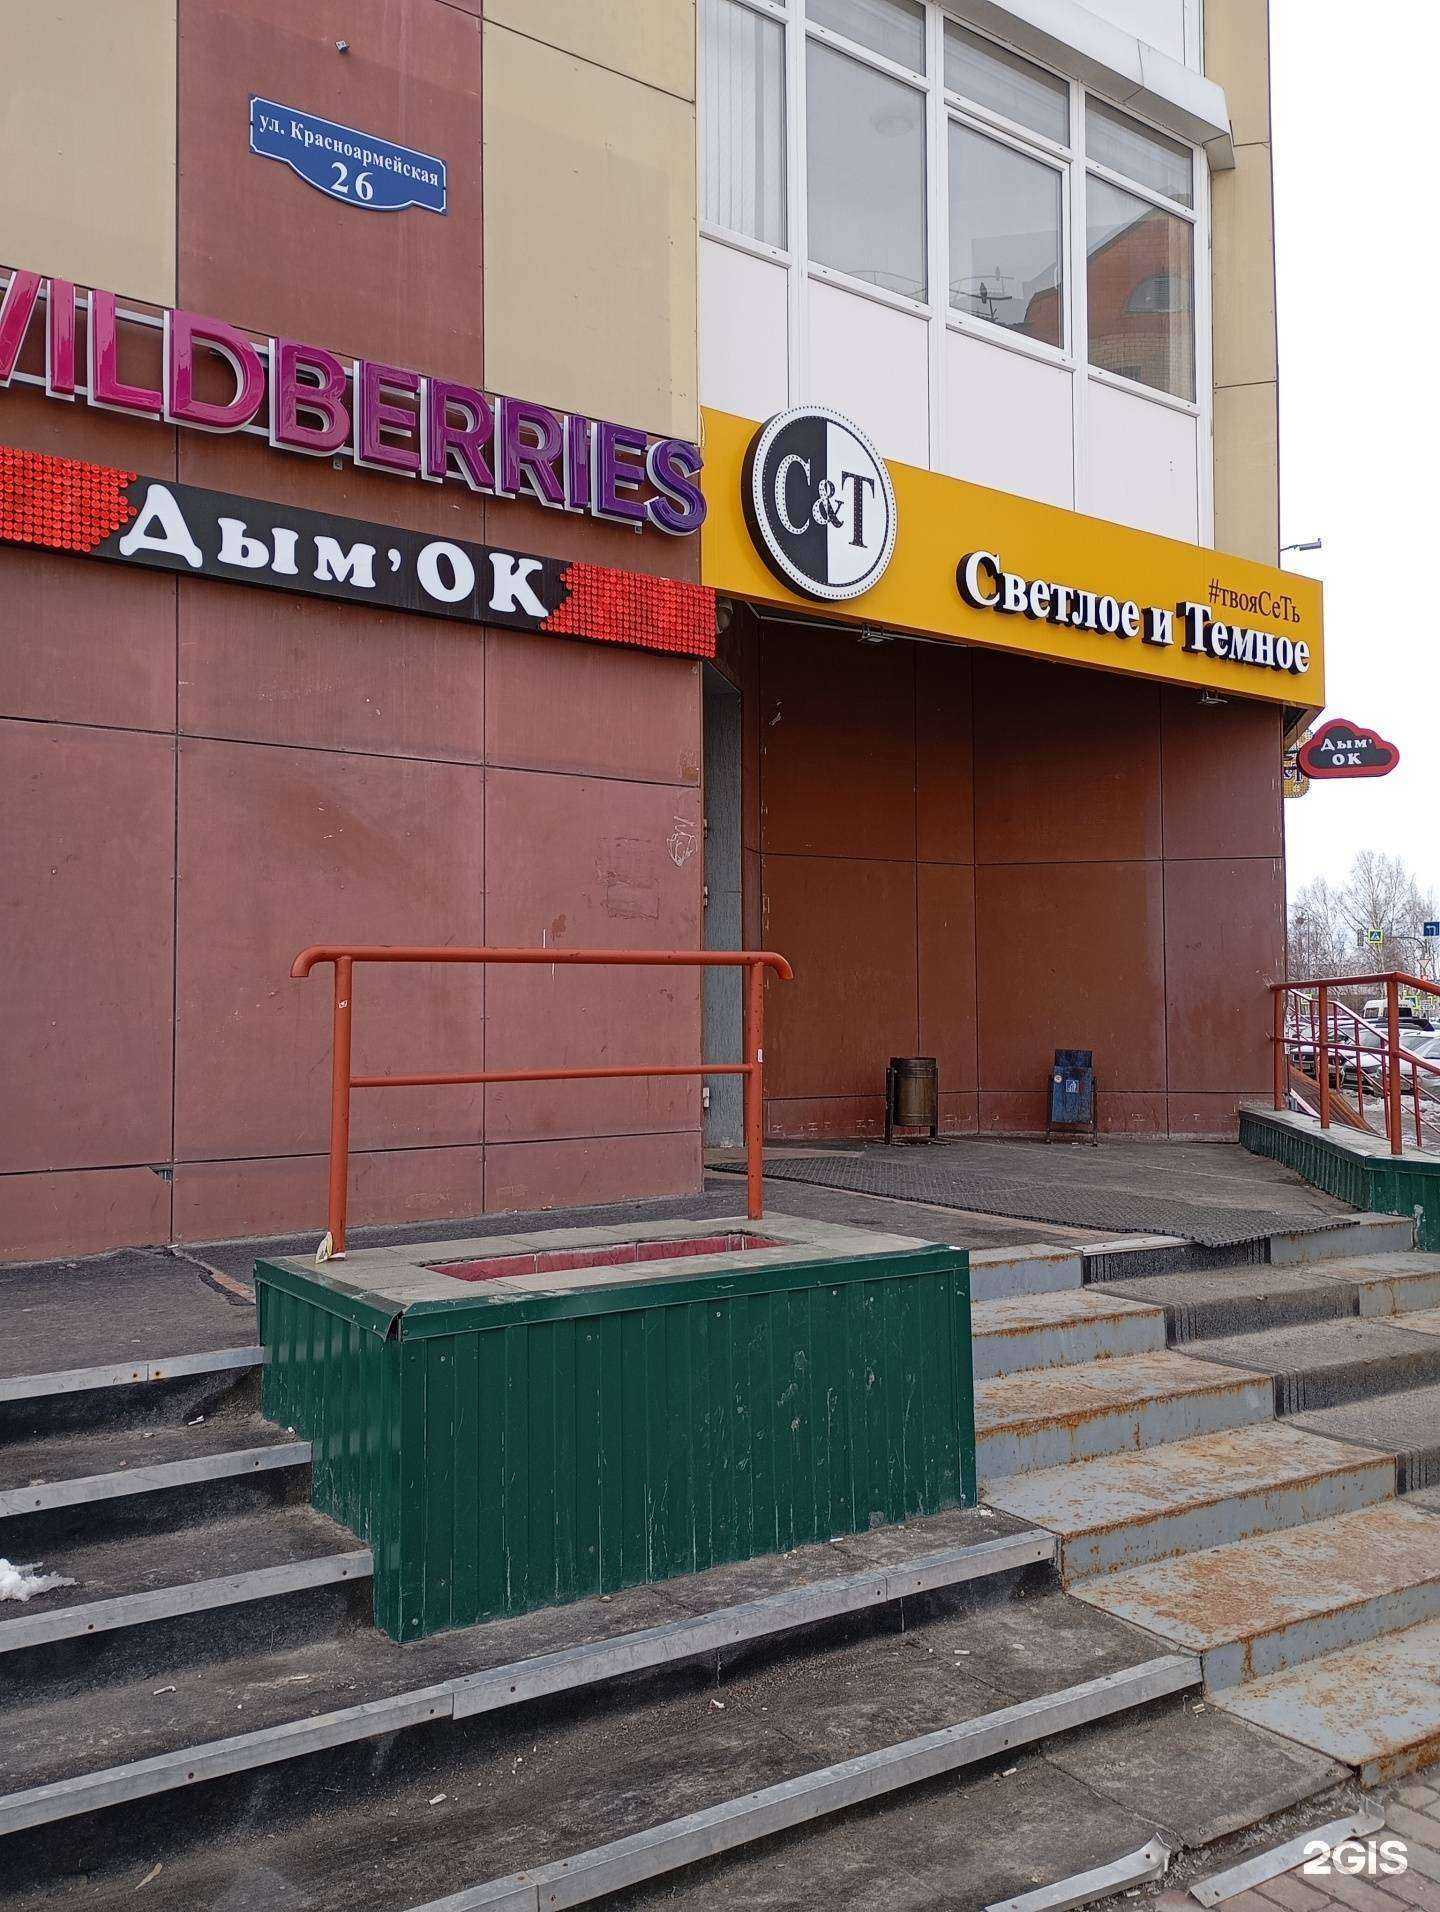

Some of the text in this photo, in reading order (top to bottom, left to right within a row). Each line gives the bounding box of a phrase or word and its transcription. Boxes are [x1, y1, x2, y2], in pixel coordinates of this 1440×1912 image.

[259, 114, 439, 187] ул. Красноармейская
[331, 161, 374, 200] 26
[962, 550, 1311, 673] Светлое и Темное
